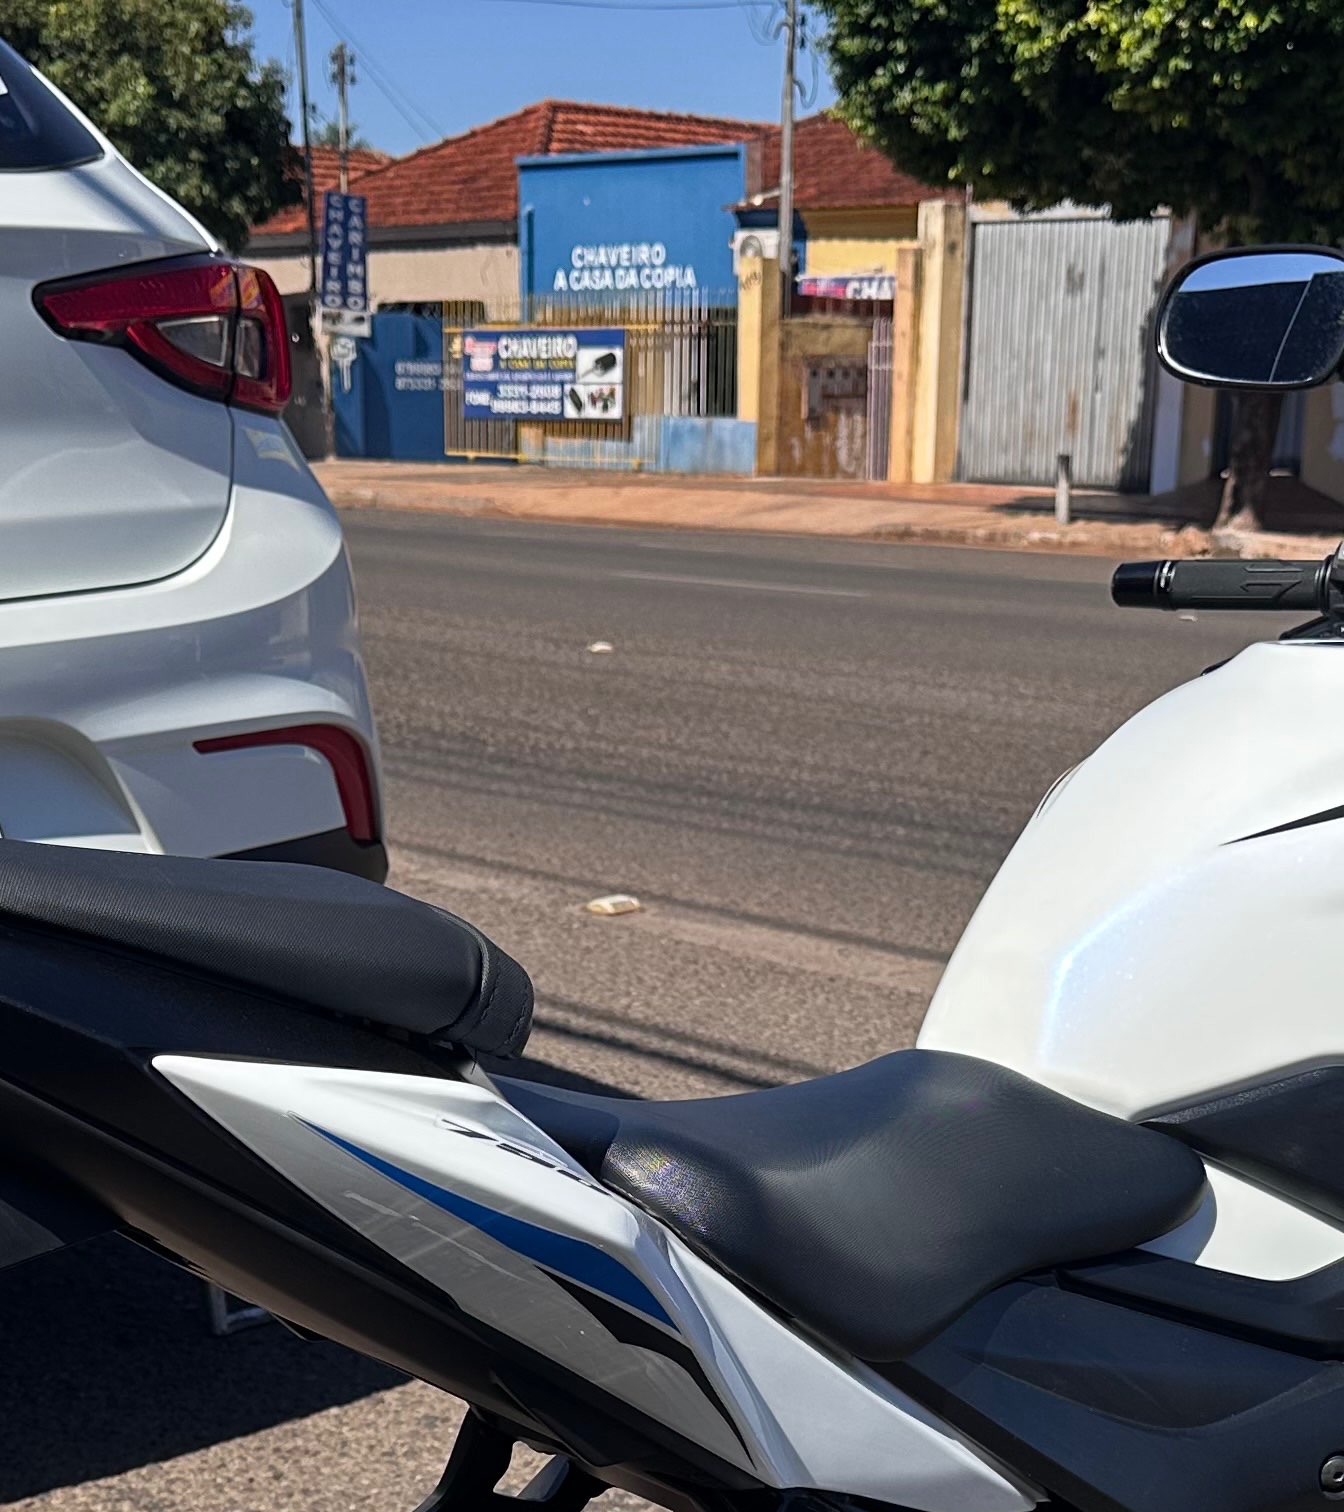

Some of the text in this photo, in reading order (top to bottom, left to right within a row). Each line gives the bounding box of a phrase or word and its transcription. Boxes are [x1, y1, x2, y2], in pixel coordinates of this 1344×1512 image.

[571, 242, 666, 268] CHAVEIRO
[553, 267, 568, 291] A
[569, 266, 614, 291] CASA
[614, 266, 640, 290] DA
[845, 279, 894, 300] CHA
[497, 334, 578, 359] CHAVEIRO
